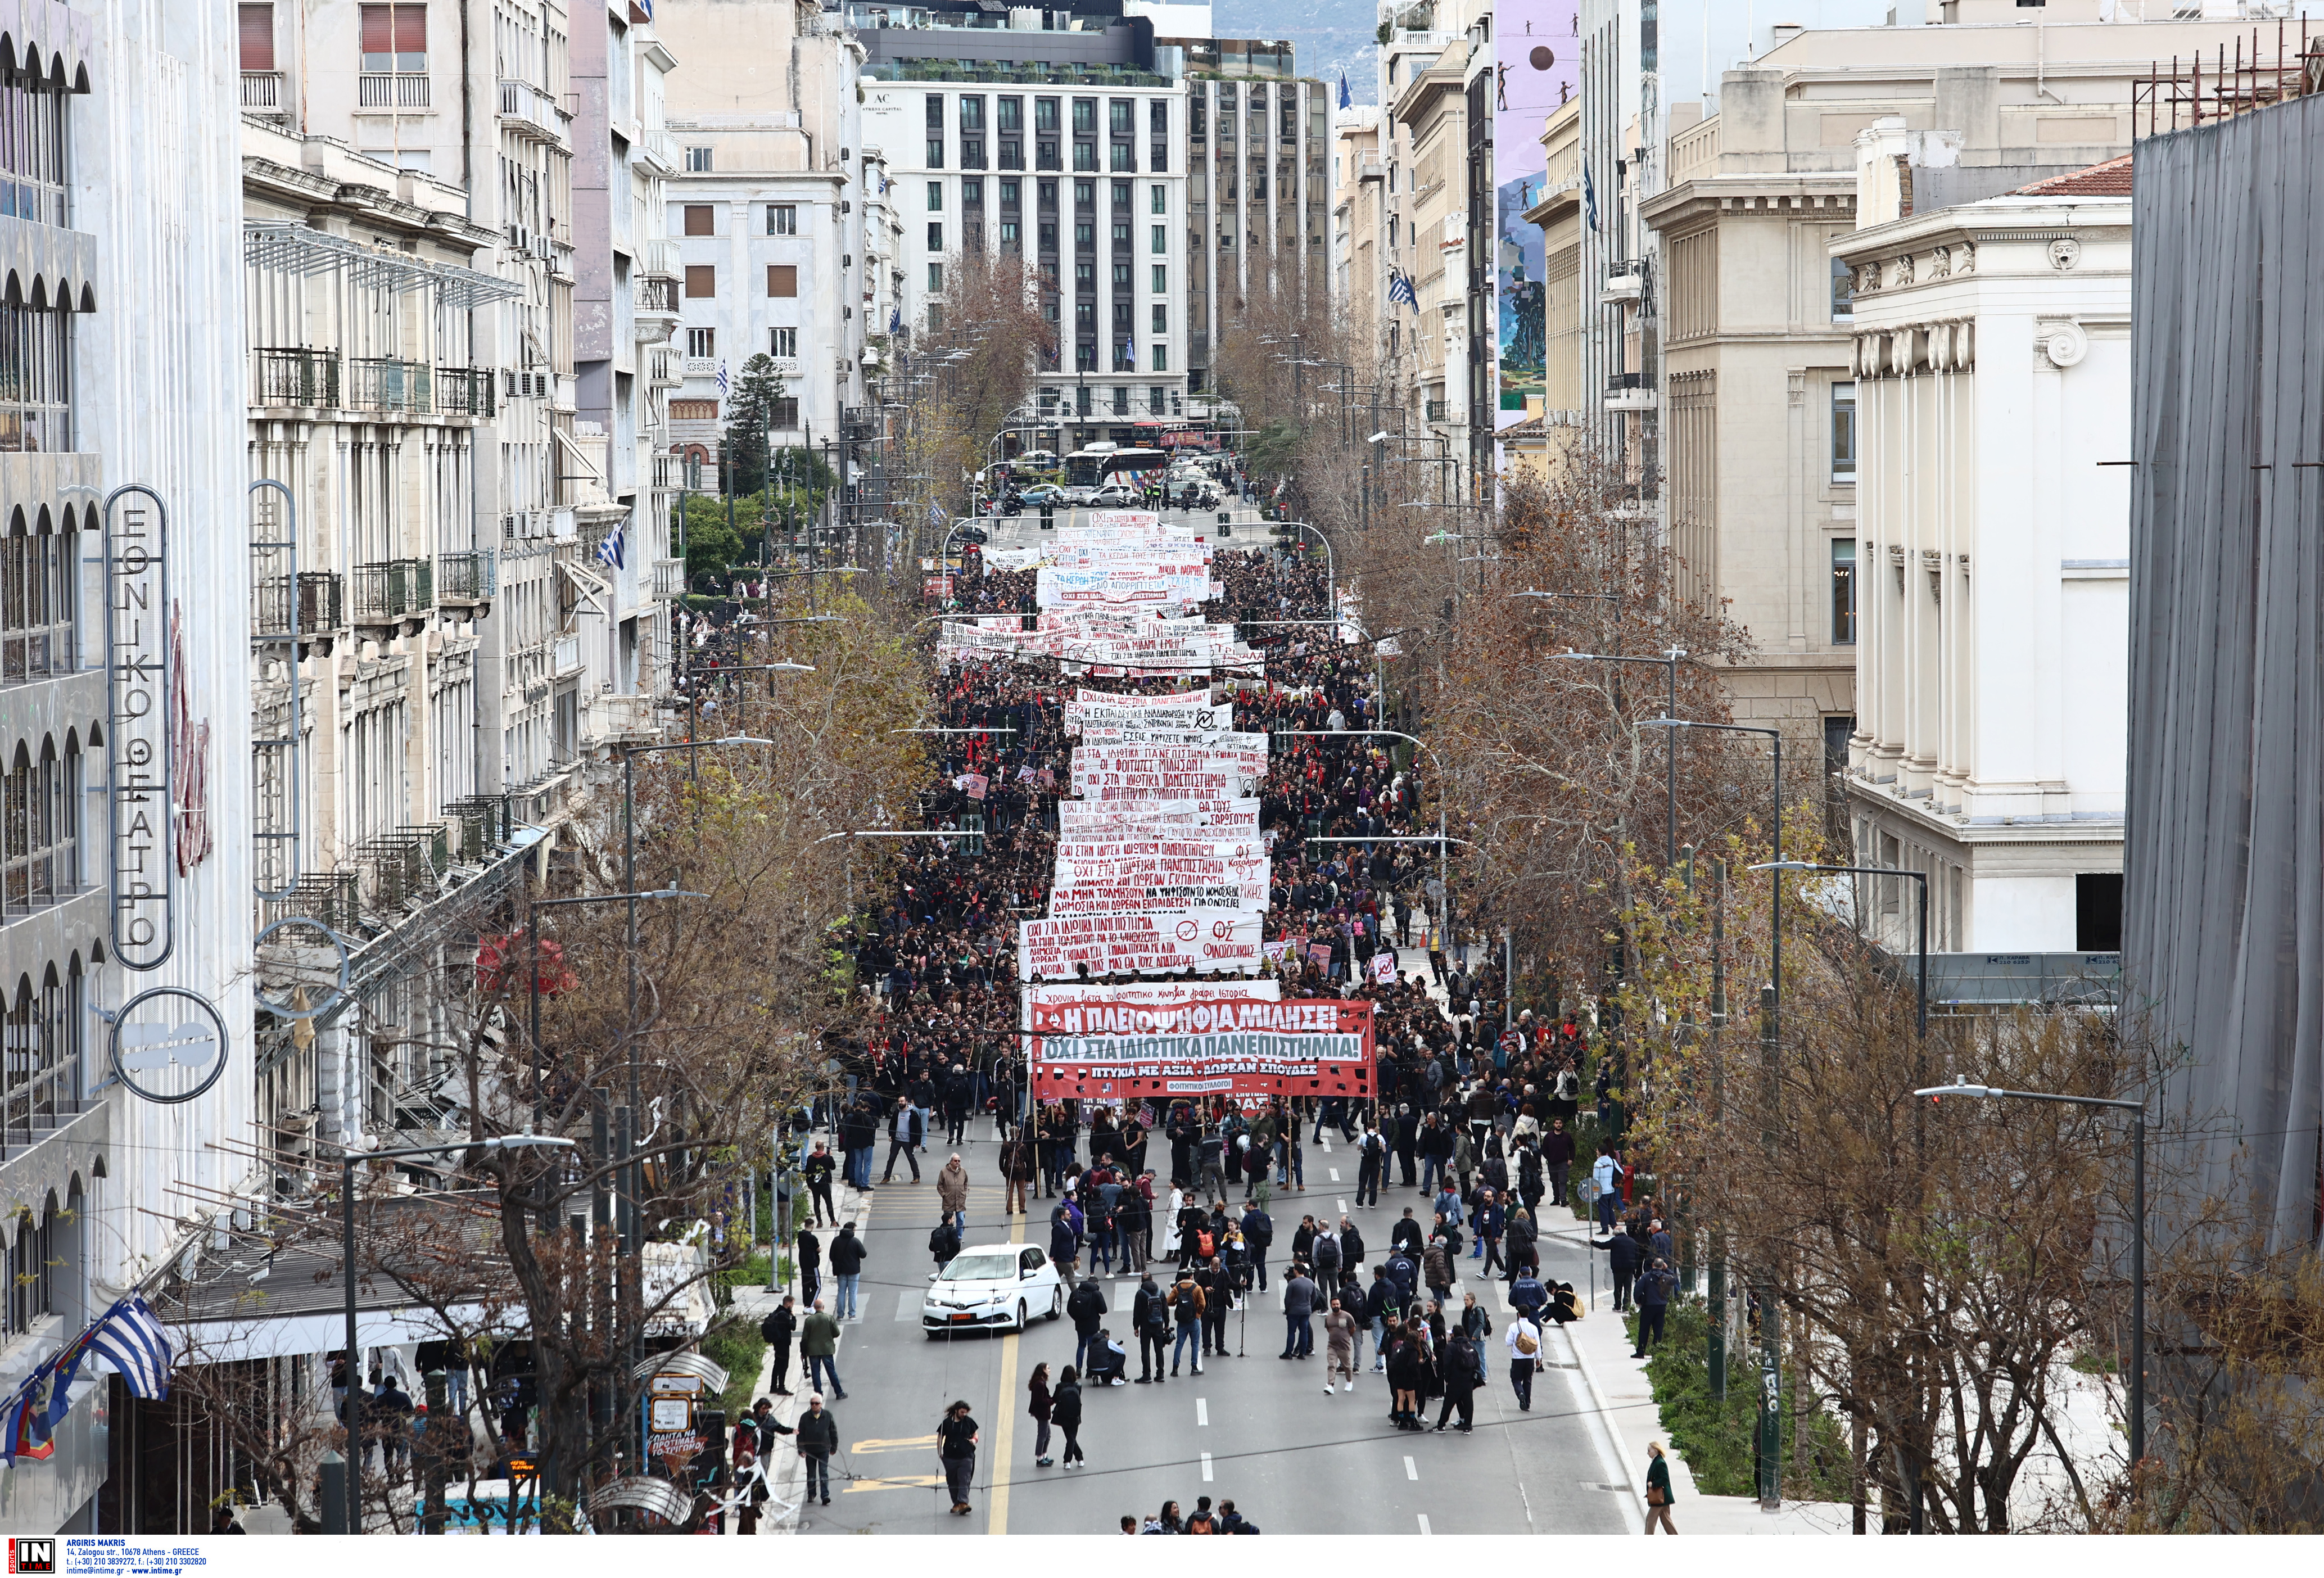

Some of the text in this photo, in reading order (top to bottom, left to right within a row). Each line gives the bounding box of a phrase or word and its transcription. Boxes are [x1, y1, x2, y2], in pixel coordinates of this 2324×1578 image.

[874, 94, 889, 103] AC
[1092, 512, 1106, 523] ΟΧΙ
[1084, 530, 1115, 538] ΑΠΕΝΑΝΤΙ
[1079, 548, 1088, 557] ΟΧΙ
[1181, 564, 1205, 576] ΝΟΜΟΣ
[1193, 577, 1202, 587] ΜΕ
[1082, 691, 1115, 703] ΟΧΙ ΣΤΑ
[1085, 708, 1184, 719] Η ΕΚΠΑΙΔΕΥΤΙΚΗ ΑΝΑΔΙΑΡΘΡΩΣΗ
[1085, 720, 1123, 729] ΙΔΙΩΤΙΚΟΠΟΙΗΣΗ
[1144, 719, 1173, 729] ΣΥΝΤΡΙΒΟΝΤΑΙ
[1084, 738, 1089, 746] ΟΙ
[1124, 732, 1146, 741] ΕΣΕΙΣ
[1151, 733, 1179, 743] ΨΗΦΙΖΕΤΕ
[1184, 734, 1202, 743] ΝΟΜΟΥΣ
[1100, 758, 1202, 772] ΟΙ ΦΟΙΤΗΤΕΣ ΜΙΛΗΣΑΝ!
[1088, 773, 1226, 788] ΟΧΙ ΣΤΑ ΙΔΙΩΤΙΚΑ ΠΑΝΕΠΙΣΤΗΜΙΑ
[1064, 801, 1160, 813] ΟΧΙ ΣΤΑ ΙΔΙΩΤΙΚΑ ΠΑΝΕΠΙΣΤΗΜΙΑ
[1199, 801, 1231, 812] ΘΑ ΤΟΥΣ
[1210, 813, 1255, 825] ΣΑΡΩΣΟΥΜΕ
[1060, 843, 1159, 857] ΟΧΙ ΣΤΗΝ ΙΔΡΥΣΗ ΙΔΙΩΤΙΚΩΝ
[1074, 865, 1092, 877] ΟΧΙ
[1097, 863, 1114, 877] ΣΤΑ
[1120, 858, 1156, 875] ΙΔΙΩΤΙΚΑ
[1161, 858, 1223, 874] ΠΑΝΕΠΙΣΤΗΜΙΑ
[1055, 885, 1195, 901] ΝΑ ΜΗΝ ΤΟΛΜΗΣΟΥΝ ΝΑ ΨΗΦΙΣΟΥΝ
[1054, 898, 1206, 912] ΔΗΜΟΣΙΑ ΚΑΙ ΔΩΡΕΑΝ ΕΚΠΑΙΔΕΥΣΗ ΓΙΑ
[1028, 916, 1153, 937] ΟΧΙ ΣΤΑ ΙΔΙΩΤΙΚΑ ΠΑΝΕΠΙΣΤΗΜΙΑ
[1029, 932, 1159, 947] ΝΑ ΜΗΝ ΝΑ ΤΟ ΨΗΦΙΣΟΥΝ
[1030, 947, 1061, 956] ΔΗΜΟΣΙΑ
[1031, 942, 1159, 964] ΔΩΡΕΑΝ ΕΚΠΑΙΔΕΥΣΗ ΠΤΥΧΙΑ ΜΕ
[1203, 943, 1257, 959] ΦΙΛΟΣΟΦΙΚΗΣ
[1040, 955, 1195, 975] ΑΓΩΝΑΣ ΜΑΣ ΘΑ ΤΟΥΣ ΑΝΑΤΡΕΨΕΙ
[1086, 1004, 1337, 1033] ΠΛΕΙΟΨΗΦΙΑ ΜΙΛΗΣΕ!
[1045, 1034, 1358, 1060] ΟΧΙ ΣΤΑ ΙΔΙΩΤΙΚΑ ΠΑΝΕΠΙΣΤΗΜΙΑ!
[1092, 1062, 1318, 1078] ΠΤΥΧΙΑ ΜΕ ΑΞΙΑ ΔΩΡΕΑΝ ΣΠΟΥΔΕΣ
[1204, 1079, 1231, 1090] ΣΥΛΛΟΓΟΙ
[654, 1428, 696, 1443] ΠΑΝΤΑ ΝΑ
[653, 1436, 695, 1449] ΠΡΟΤΙΜΑΣ
[652, 1442, 701, 1457] ΤΟ ΤΡΙΓΩΝΟ
